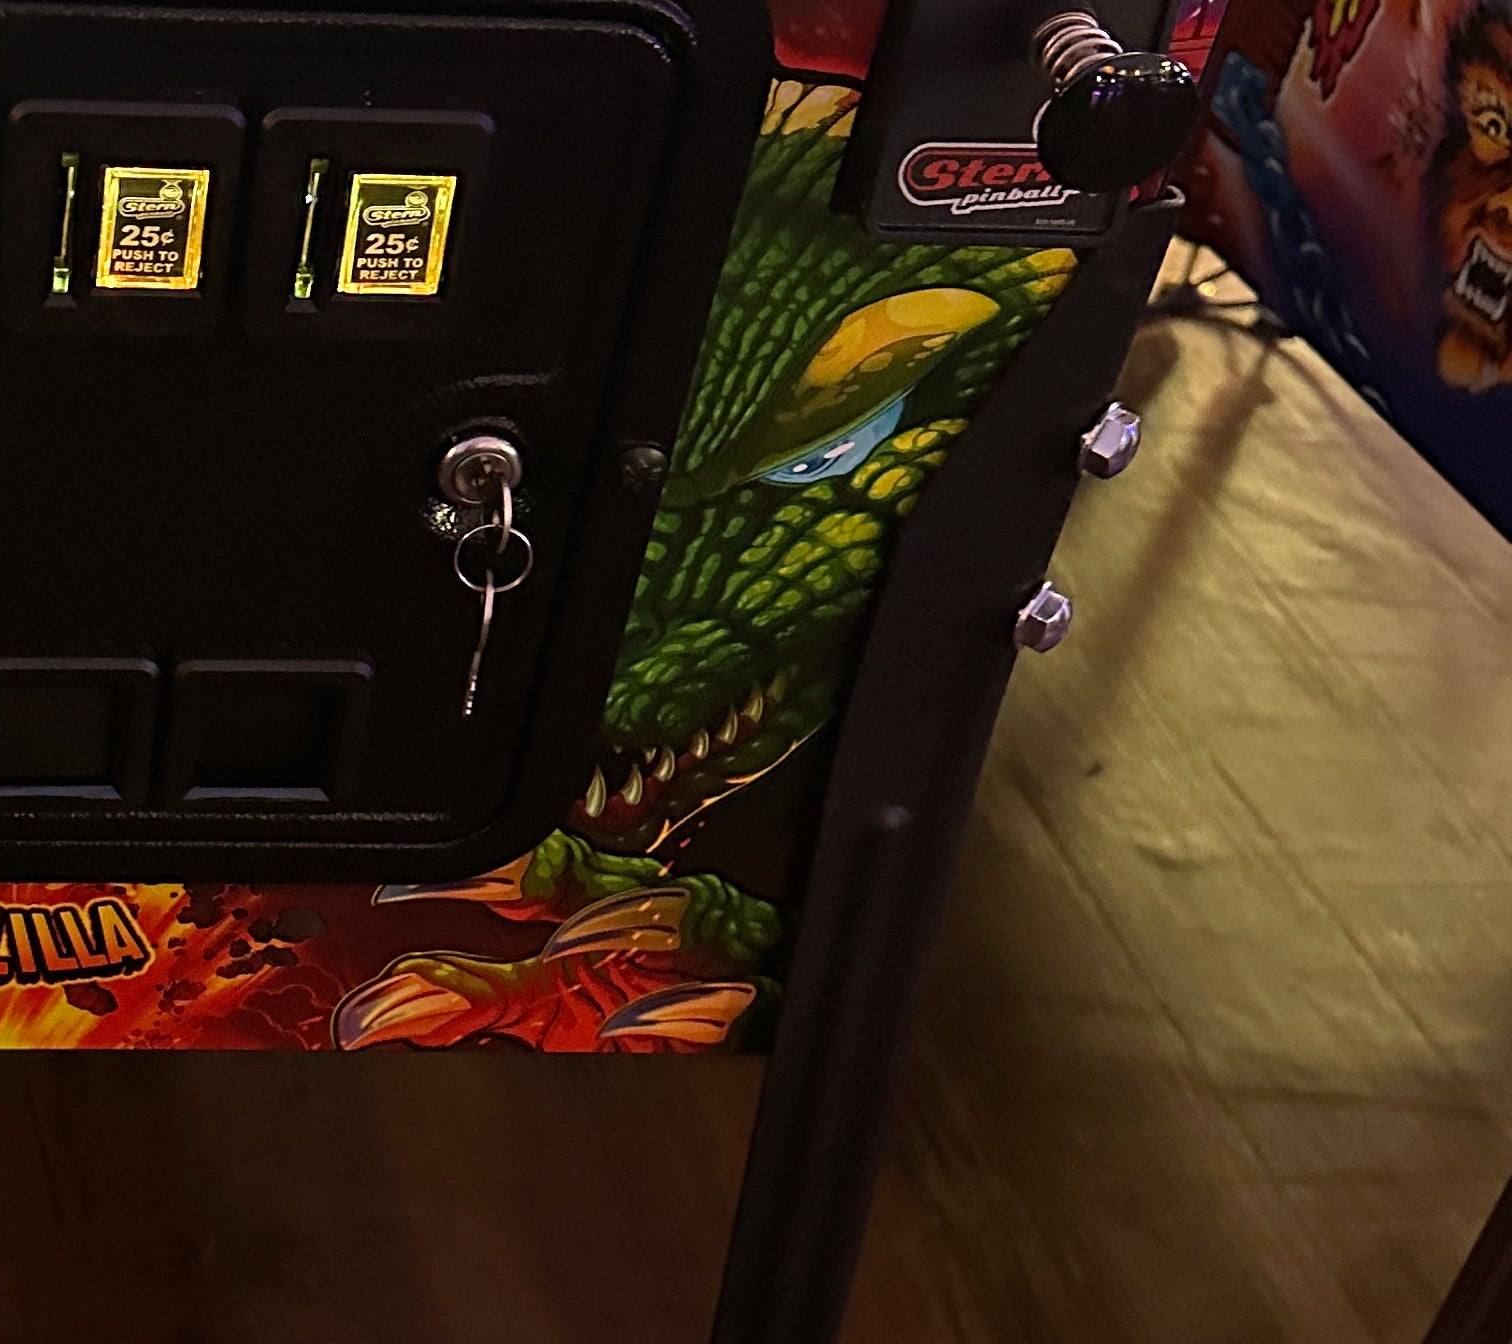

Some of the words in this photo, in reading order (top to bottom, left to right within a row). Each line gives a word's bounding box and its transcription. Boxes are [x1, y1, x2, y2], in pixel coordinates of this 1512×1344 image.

[960, 186, 1063, 207] pinball
[125, 201, 178, 213] Stern
[370, 210, 423, 222] Stern
[119, 224, 175, 247] 25¢
[365, 233, 419, 255] 25¢
[111, 248, 155, 261] PUSH
[158, 250, 179, 262] TO
[114, 261, 175, 273] REJECT
[356, 257, 399, 269] PUSH
[403, 257, 424, 268] TO
[359, 269, 420, 280] REJECT
